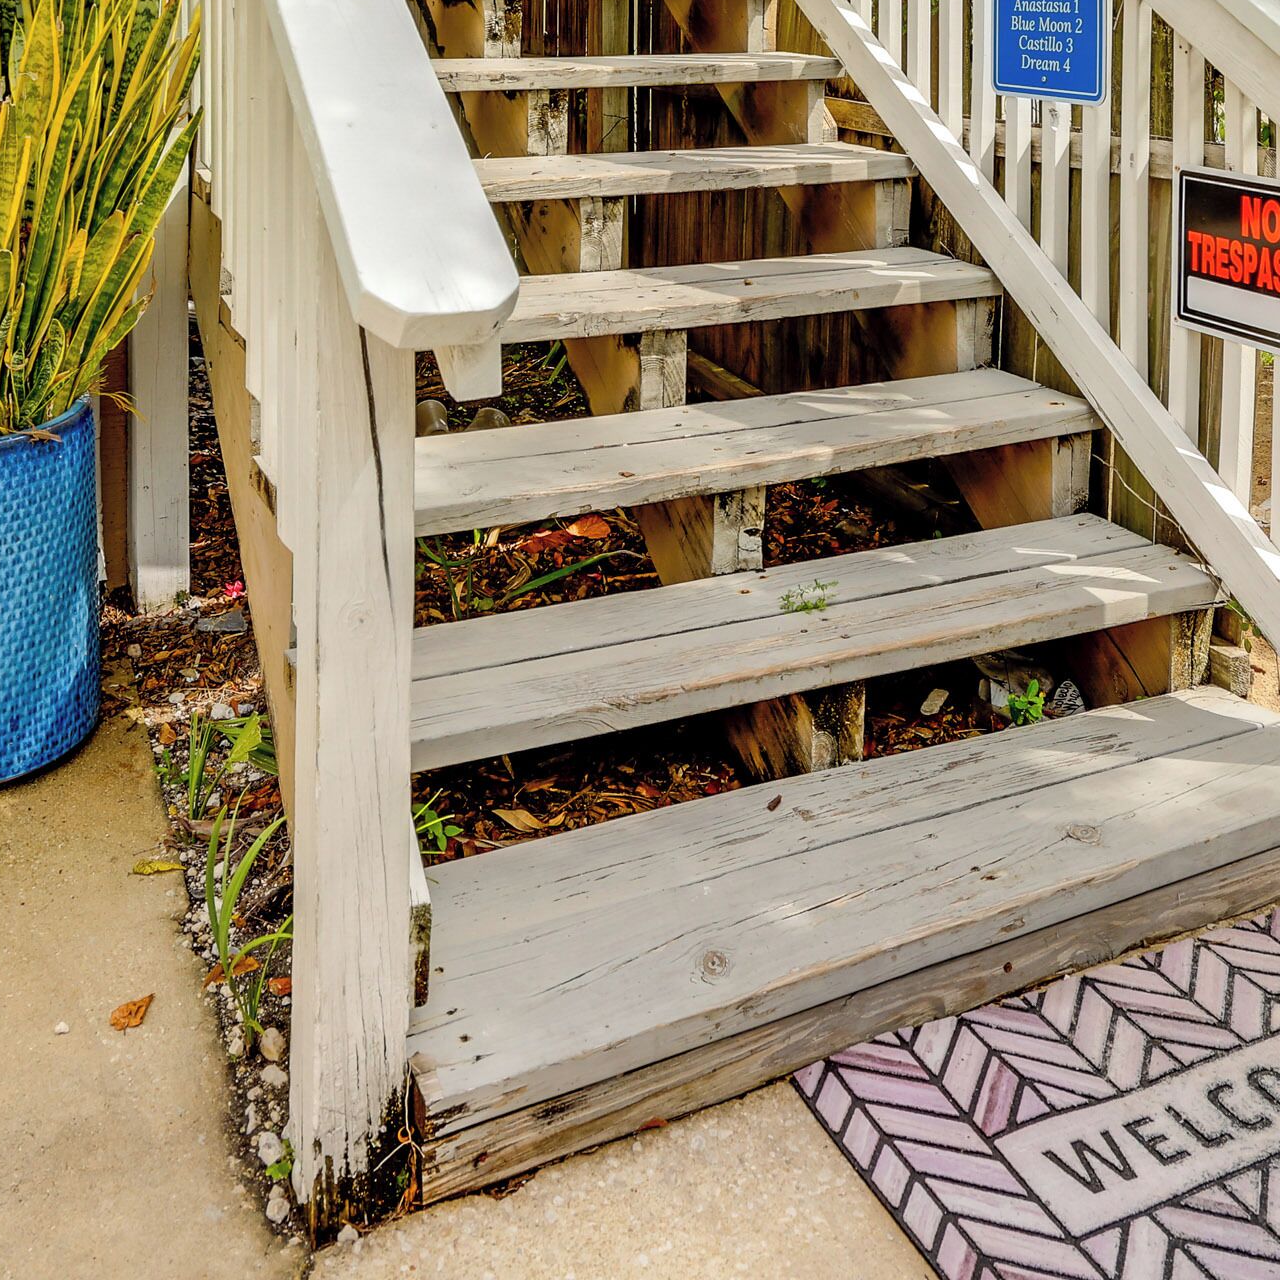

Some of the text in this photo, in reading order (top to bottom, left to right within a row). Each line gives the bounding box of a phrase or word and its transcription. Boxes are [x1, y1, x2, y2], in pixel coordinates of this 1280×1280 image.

[1010, 15, 1083, 34] Blue Moon 2
[1019, 35, 1073, 53] Castillo 3
[1021, 54, 1071, 73] Dream 4
